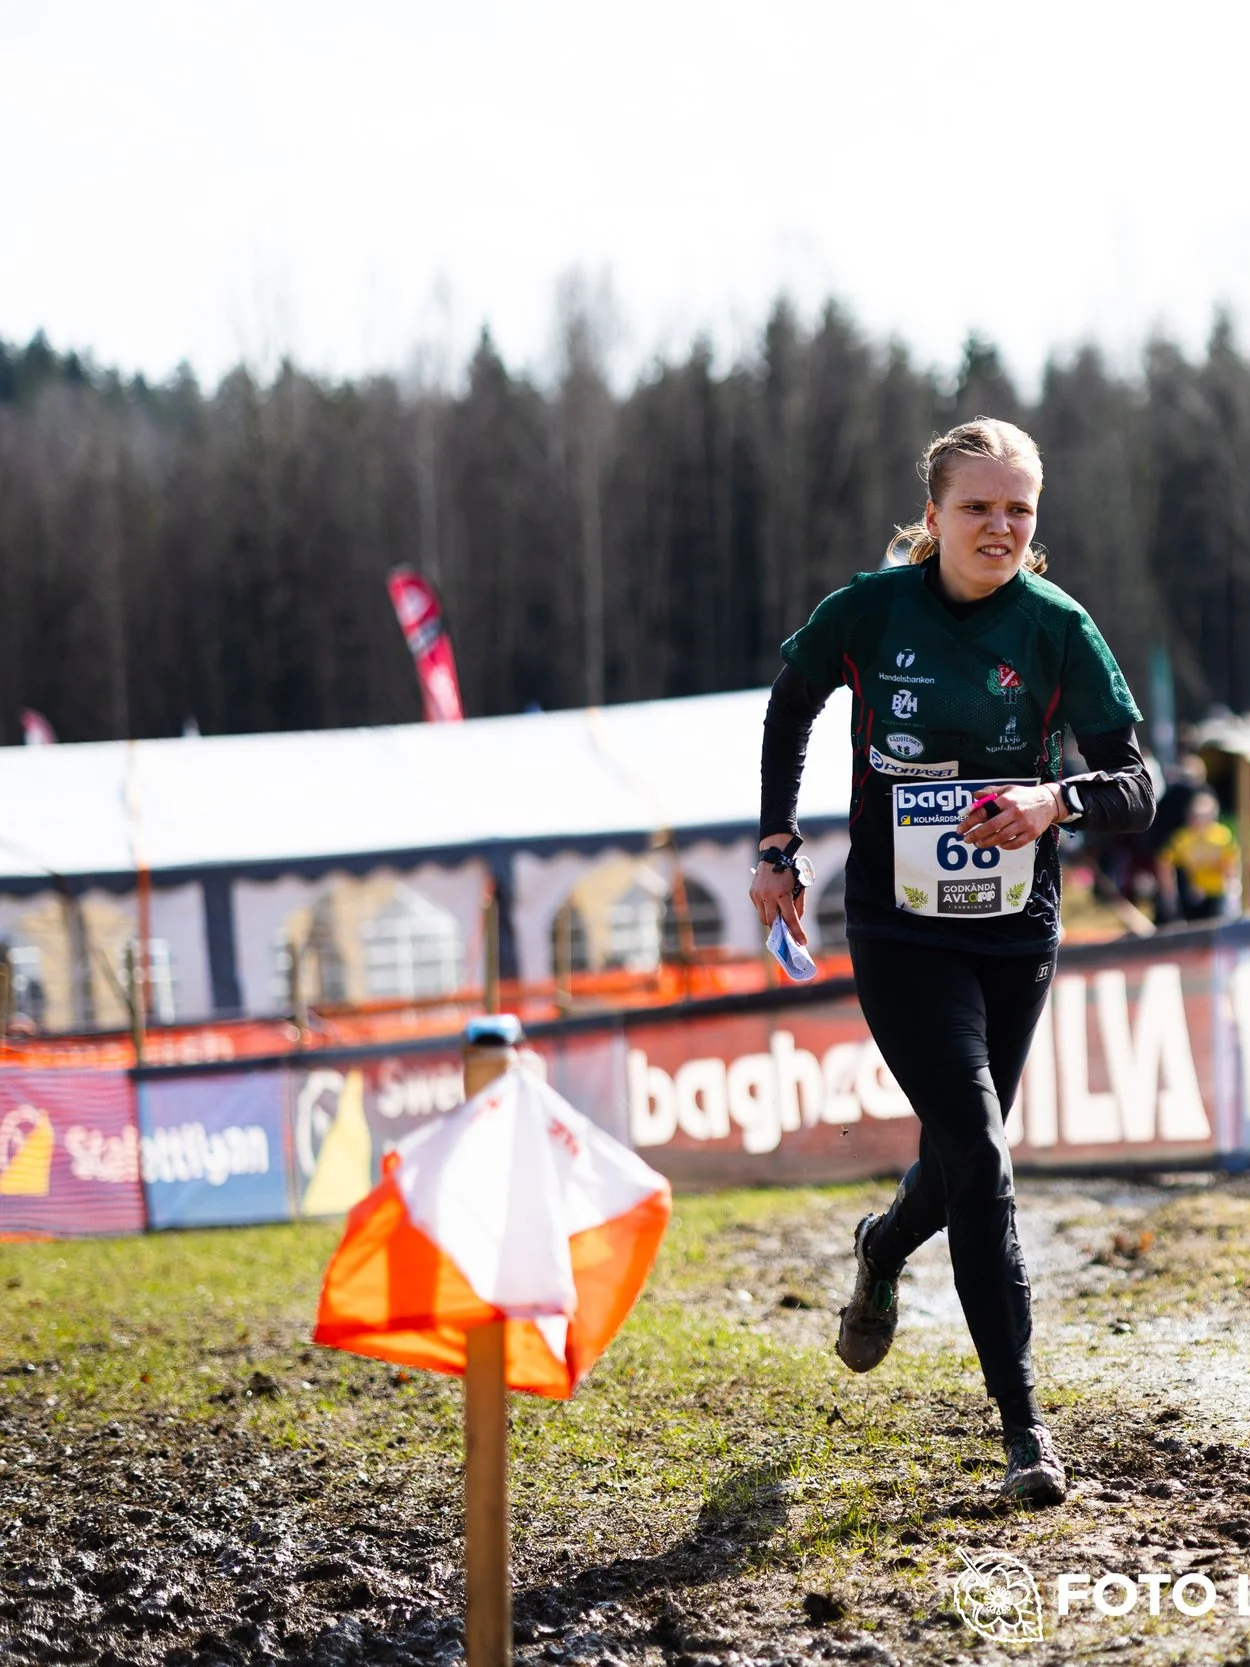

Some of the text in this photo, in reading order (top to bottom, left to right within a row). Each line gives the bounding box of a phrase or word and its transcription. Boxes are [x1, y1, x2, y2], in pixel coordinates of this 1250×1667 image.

[878, 672, 935, 684] Handelsbanken
[884, 763, 957, 778] POHJASET
[936, 831, 1000, 871] 68
[943, 883, 997, 893] GODKÄNDA
[943, 890, 996, 903] AVLOPP
[1003, 964, 1211, 1148] ILVA
